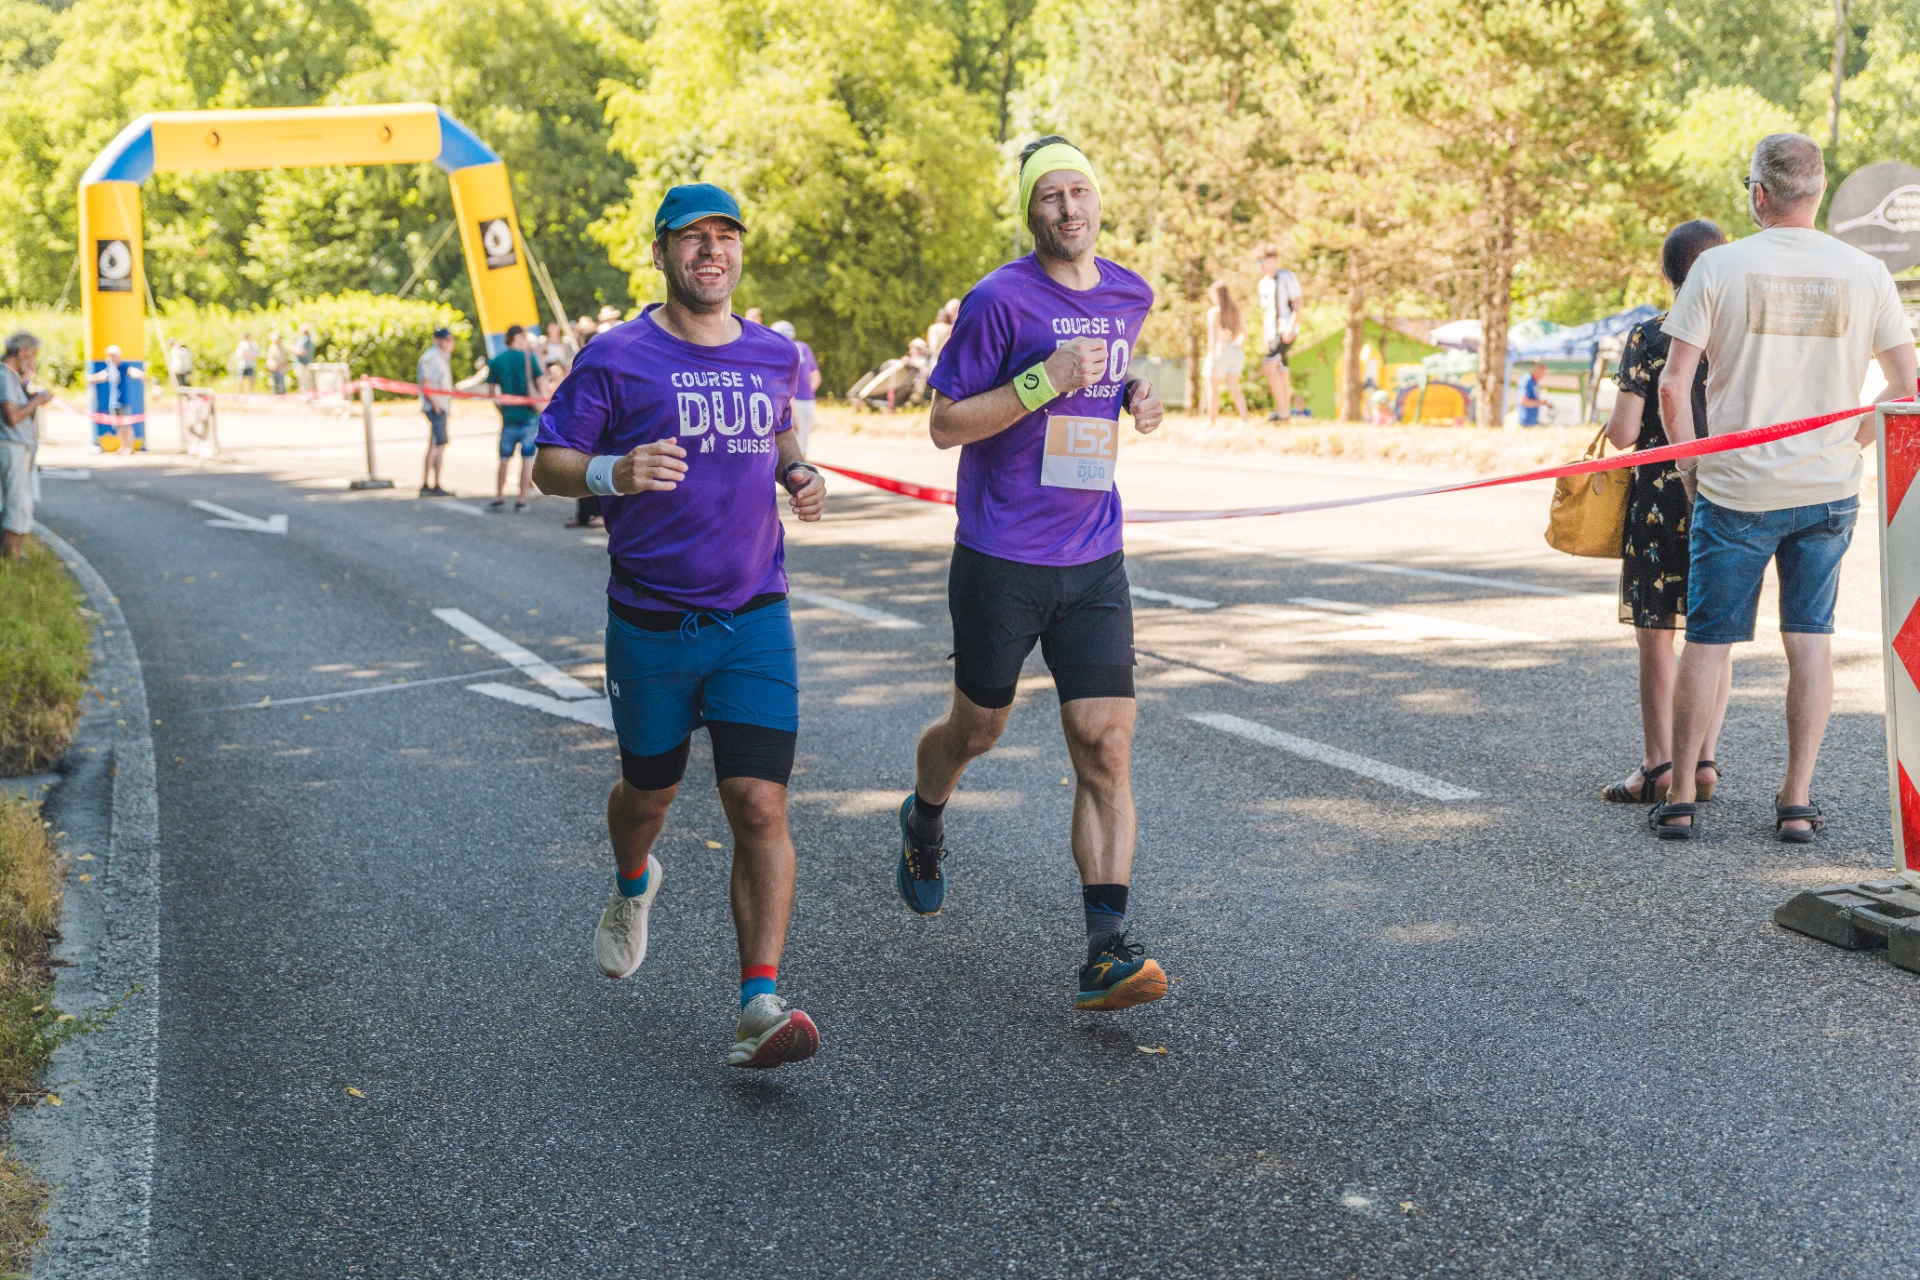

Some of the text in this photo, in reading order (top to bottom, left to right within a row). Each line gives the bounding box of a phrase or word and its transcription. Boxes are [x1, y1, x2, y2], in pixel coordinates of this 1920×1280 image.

[1789, 283, 1836, 295] LEGEND
[1052, 317, 1110, 335] COURSE
[671, 371, 744, 388] COURSE
[1084, 383, 1121, 398] SUISSE
[676, 391, 774, 437] DUO
[727, 439, 771, 454] SUISSE
[1066, 421, 1112, 456] 152
[1077, 465, 1105, 480] DUO
